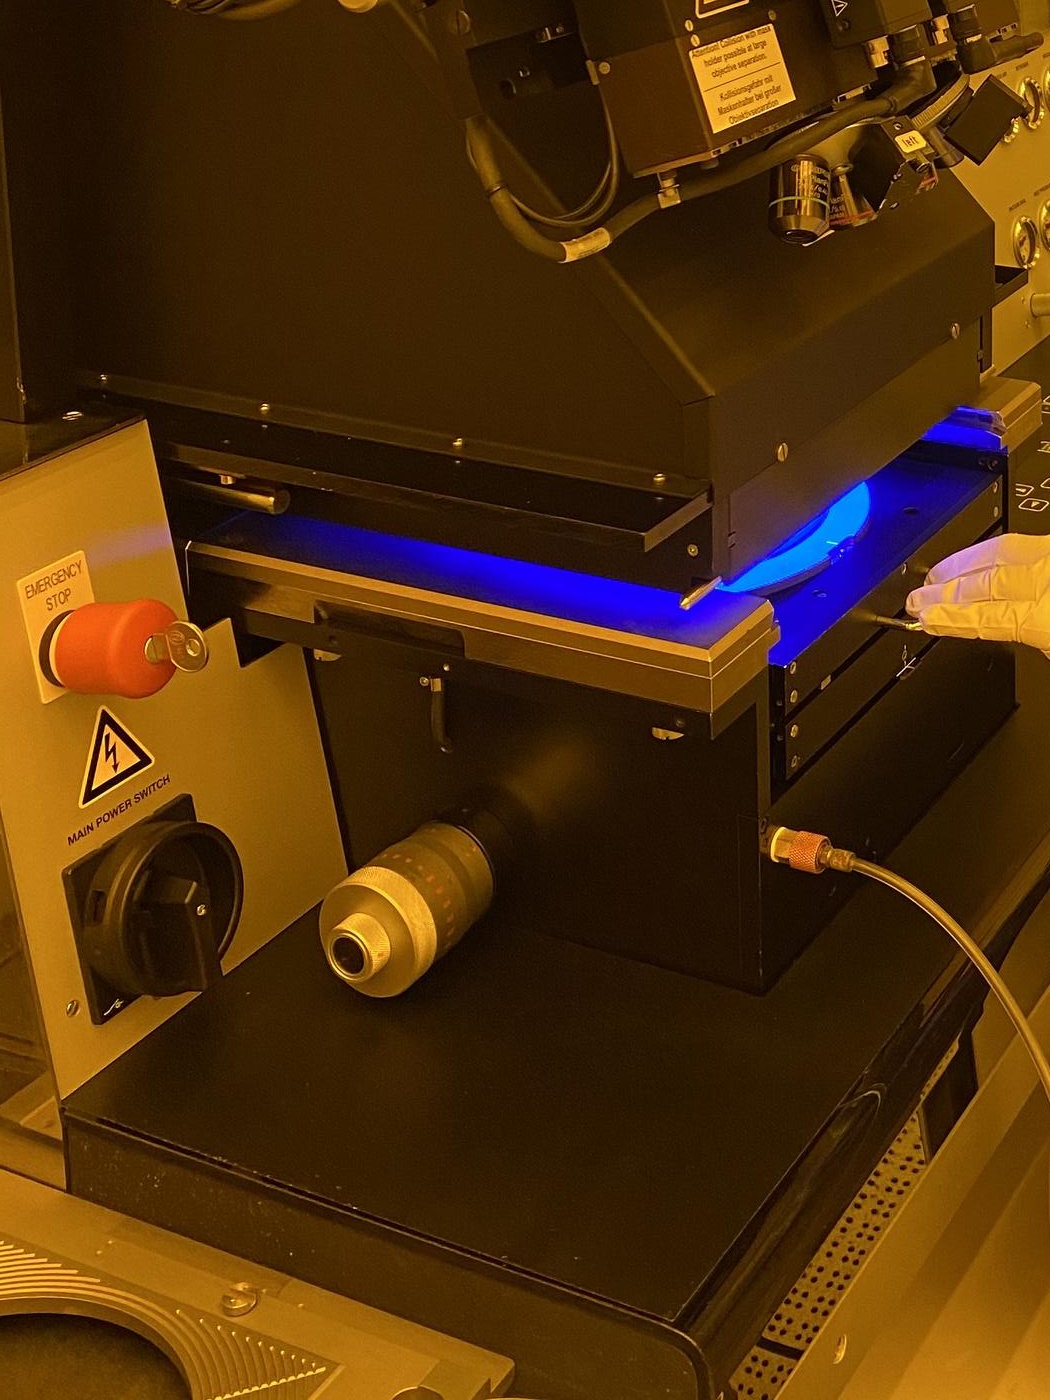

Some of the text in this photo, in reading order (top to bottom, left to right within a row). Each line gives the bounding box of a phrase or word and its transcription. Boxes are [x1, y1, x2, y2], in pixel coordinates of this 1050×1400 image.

[720, 35, 745, 48] Collision
[745, 30, 757, 39] with
[757, 25, 771, 35] mask
[704, 55, 723, 66] holder
[723, 46, 747, 63] possible
[753, 40, 767, 49] large
[711, 63, 738, 78] objective
[717, 84, 782, 115] Maskenhalter bei großer
[720, 75, 773, 101] Kollisionsgefahr mit
[901, 135, 920, 148] left
[24, 559, 83, 600] EMERGENCY
[45, 588, 72, 612] STOP
[67, 774, 171, 846] MAIN POWER SWITCH
